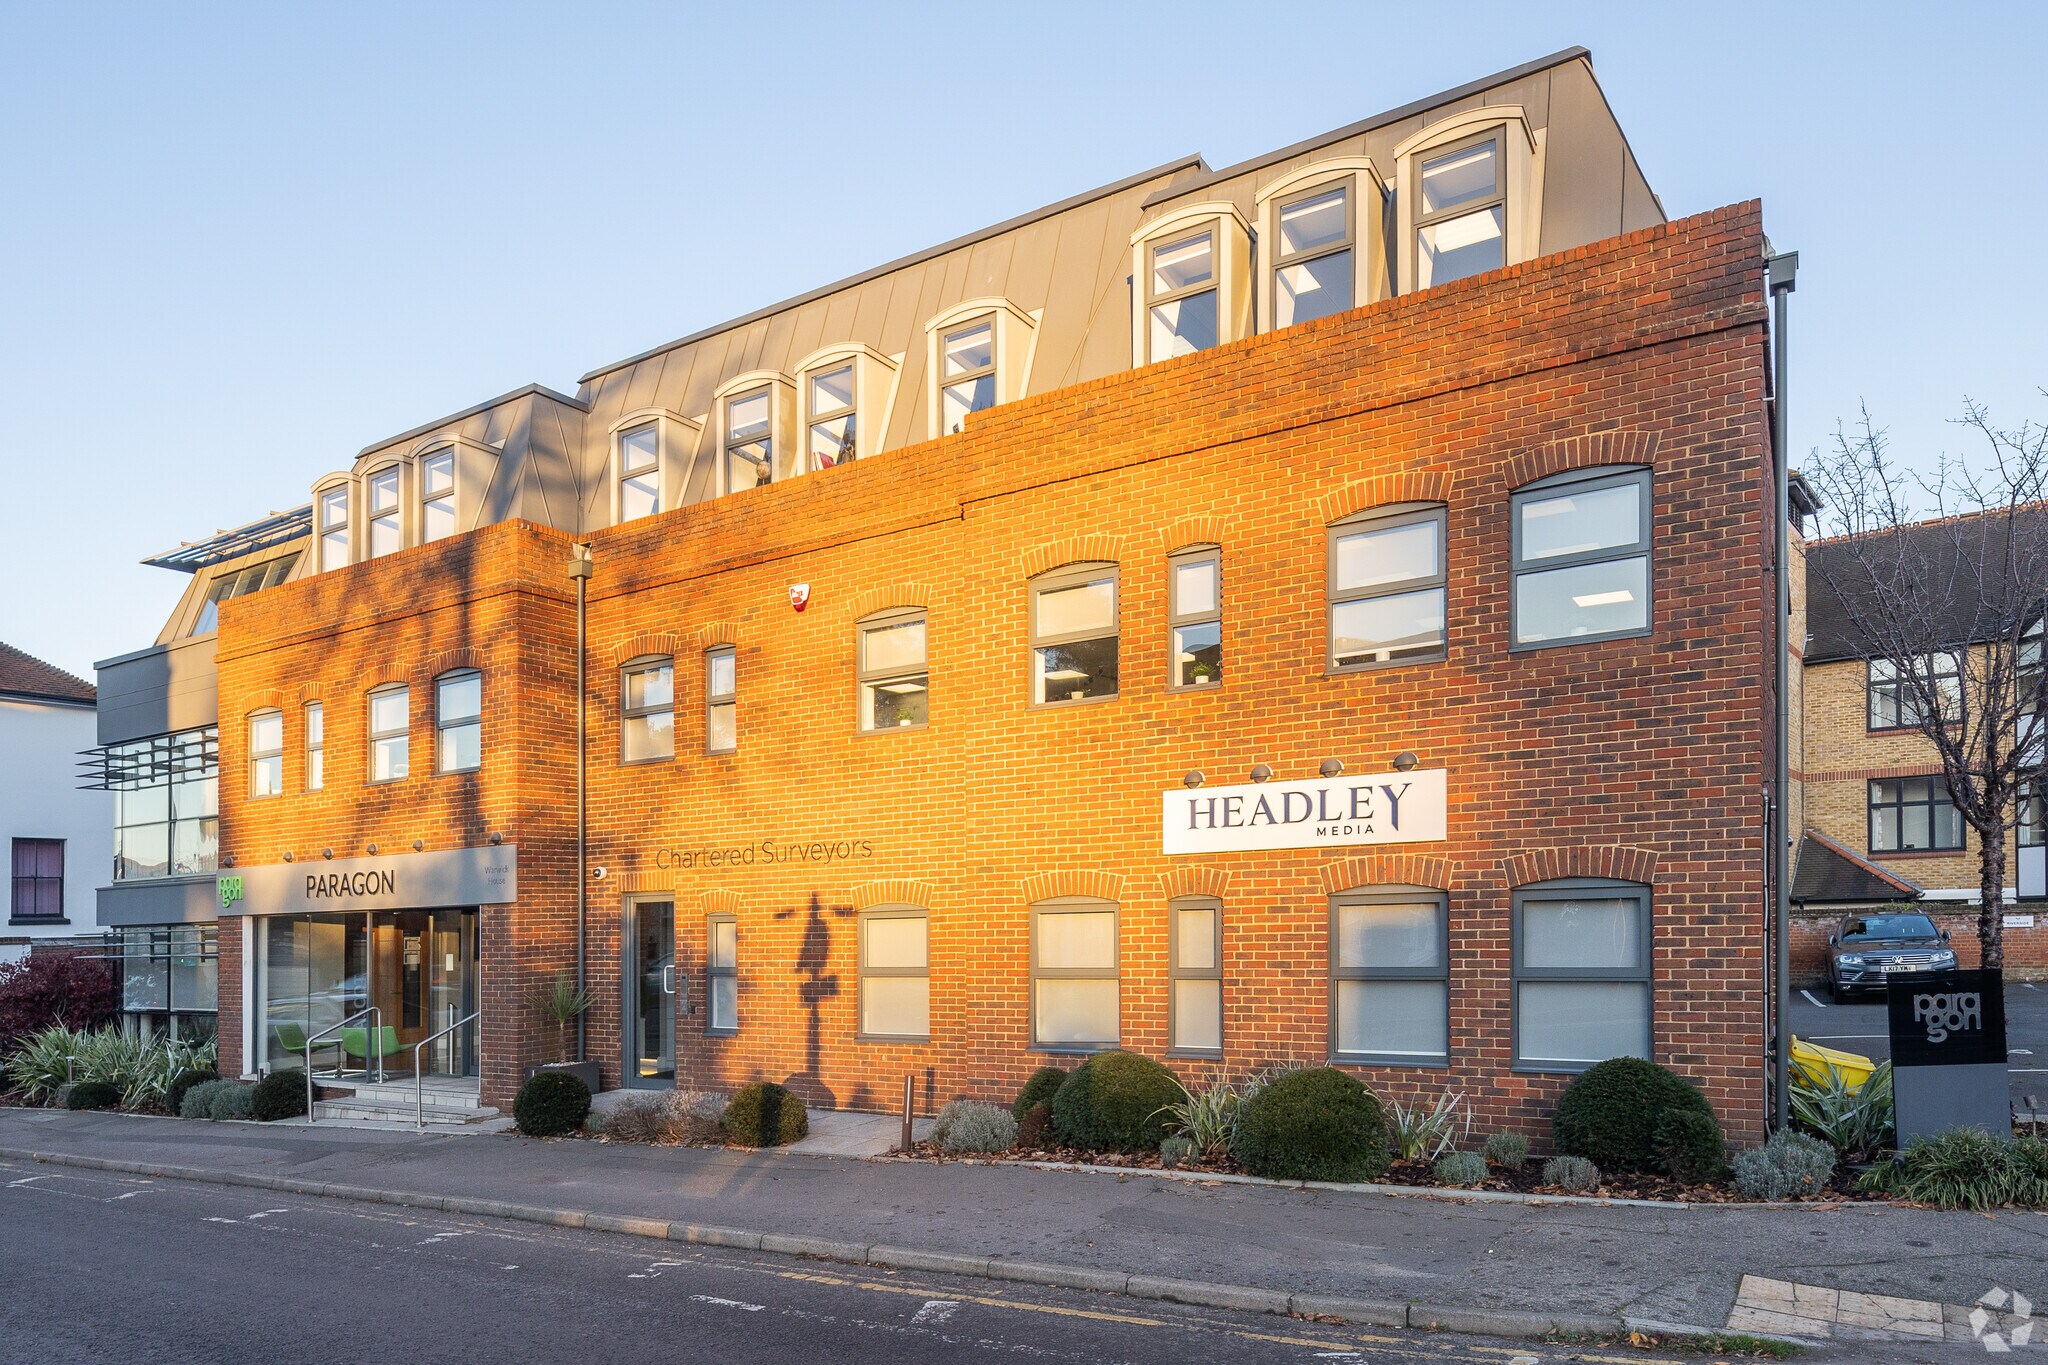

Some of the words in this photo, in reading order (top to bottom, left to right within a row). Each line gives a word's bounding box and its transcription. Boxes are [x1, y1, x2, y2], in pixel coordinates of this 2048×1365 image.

[1187, 782, 1413, 831] HEADLEY
[1316, 824, 1374, 837] MEDIA
[656, 842, 755, 869] Chartered
[761, 840, 873, 865] Surveyors
[484, 865, 509, 874] Warwick
[306, 869, 395, 898] PARAGON
[487, 877, 506, 886] House
